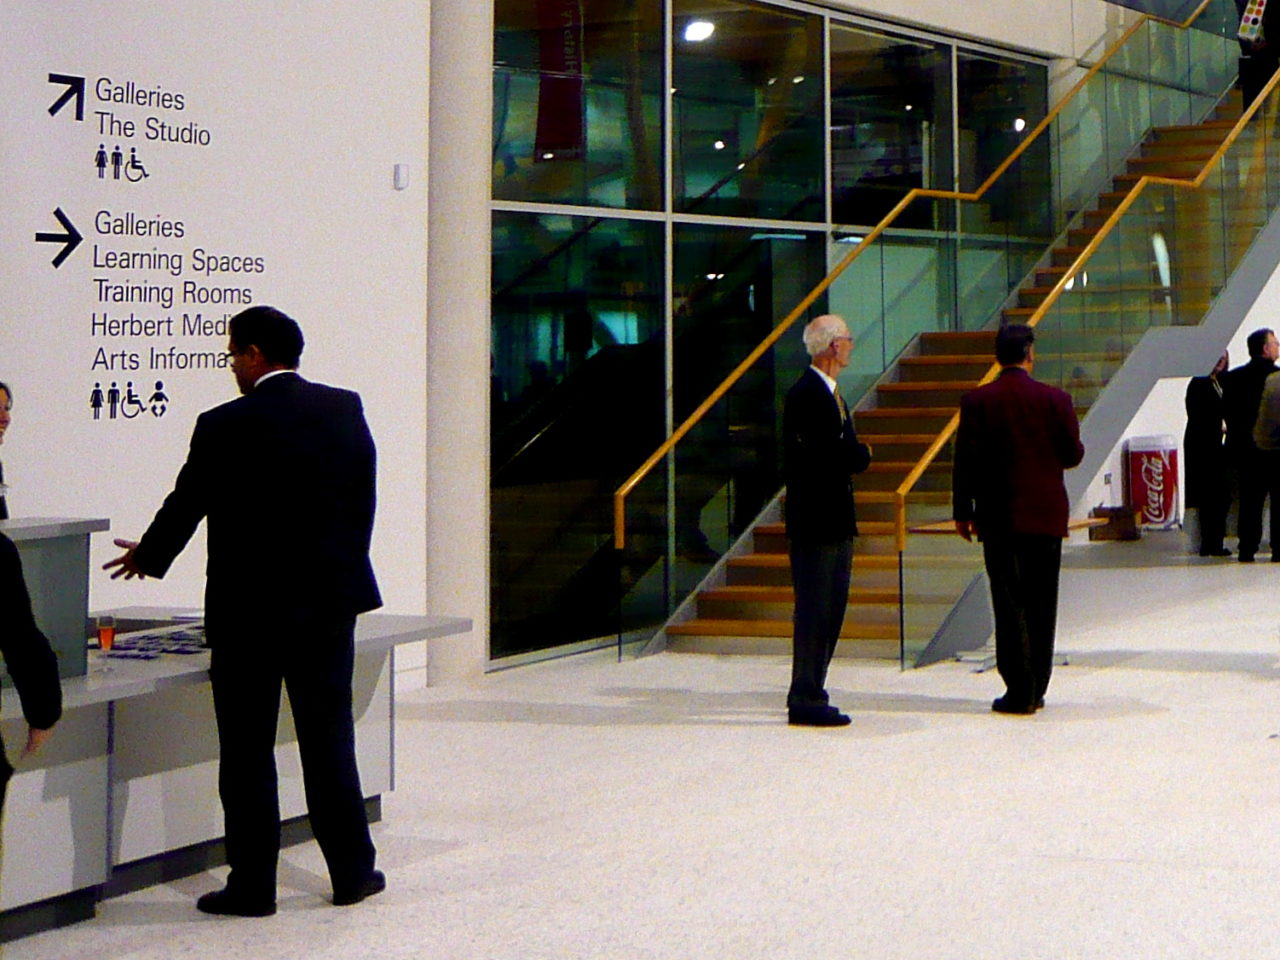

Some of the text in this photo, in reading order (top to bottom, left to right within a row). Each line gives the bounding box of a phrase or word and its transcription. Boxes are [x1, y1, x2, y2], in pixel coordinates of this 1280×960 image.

[96, 78, 184, 110] Galleries
[94, 111, 210, 145] The Studio
[95, 211, 184, 237] Galleries
[94, 245, 264, 276] Learning Spaces
[93, 279, 251, 308] Training Rooms
[92, 313, 231, 336] Herbert Medi
[92, 346, 228, 370] Arts Informa
